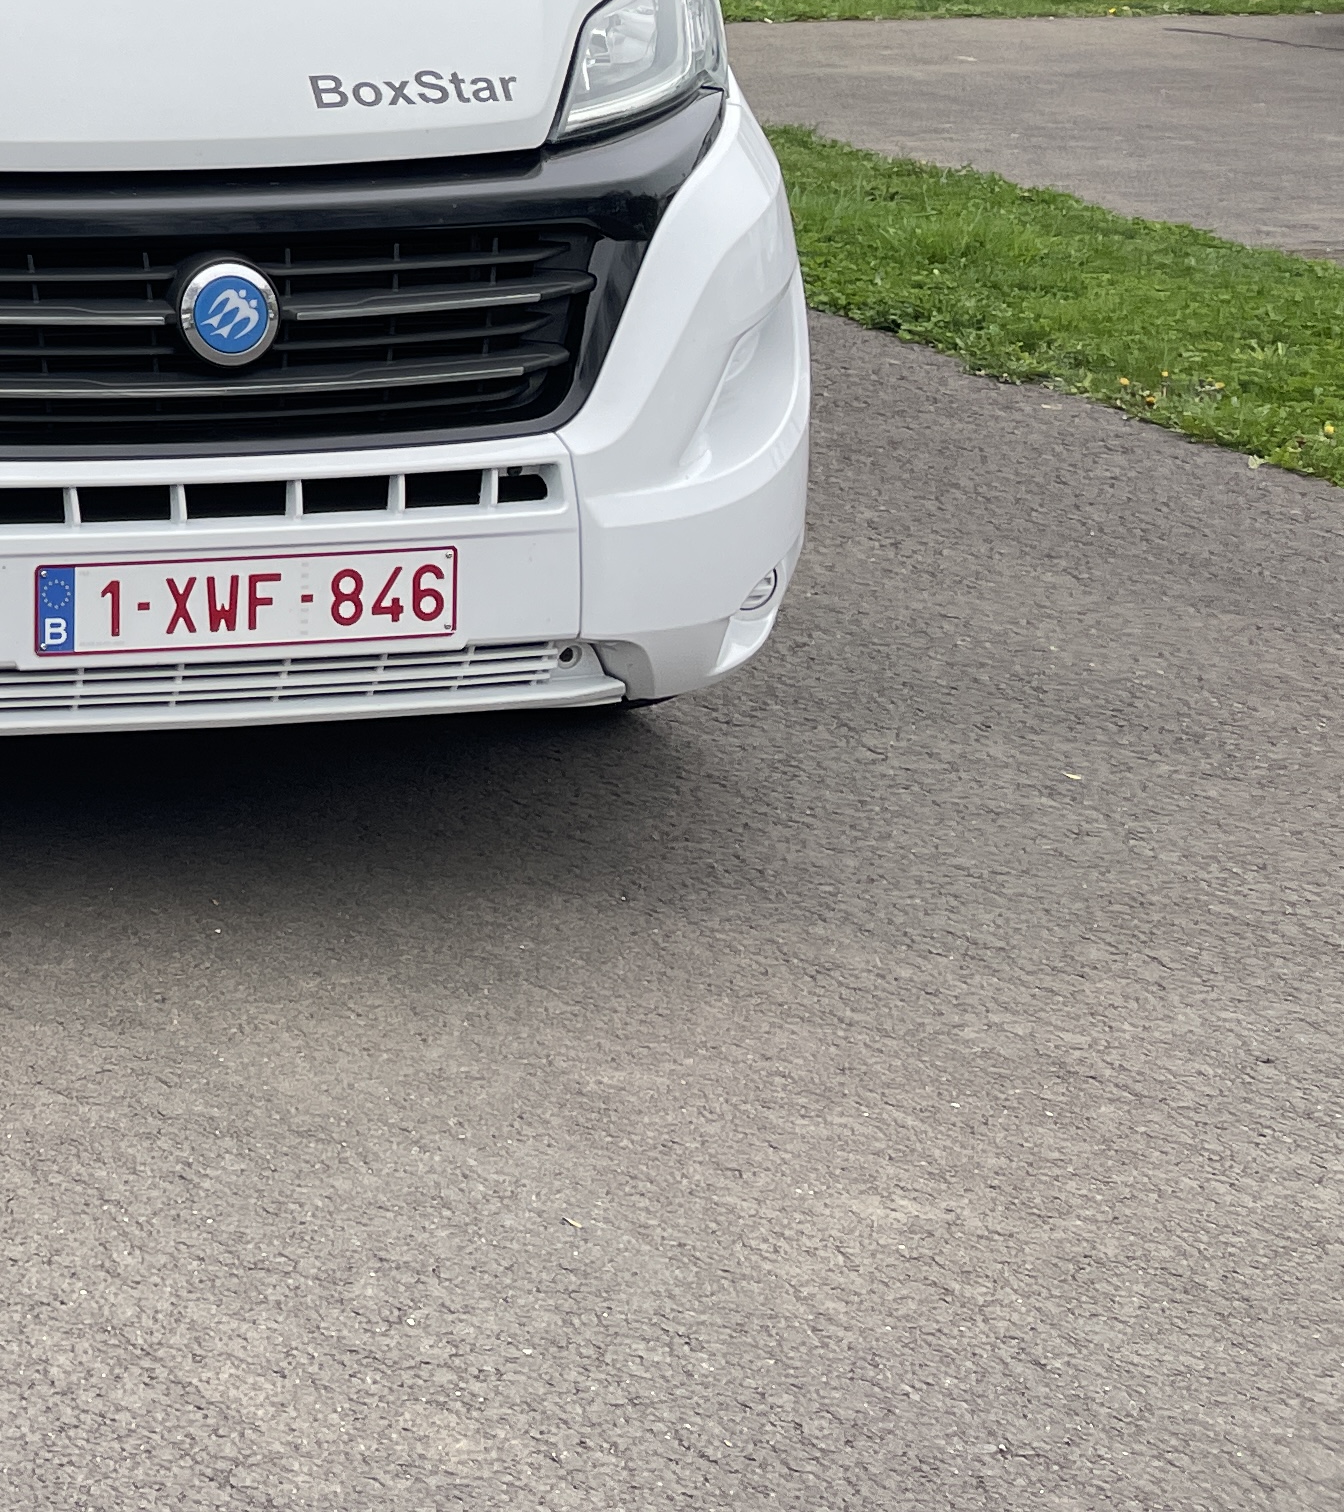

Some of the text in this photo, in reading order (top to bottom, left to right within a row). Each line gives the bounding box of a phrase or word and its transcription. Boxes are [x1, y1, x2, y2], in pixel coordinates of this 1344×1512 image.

[309, 70, 517, 109] BoxStar
[43, 563, 445, 646] B 1-XWF-846
